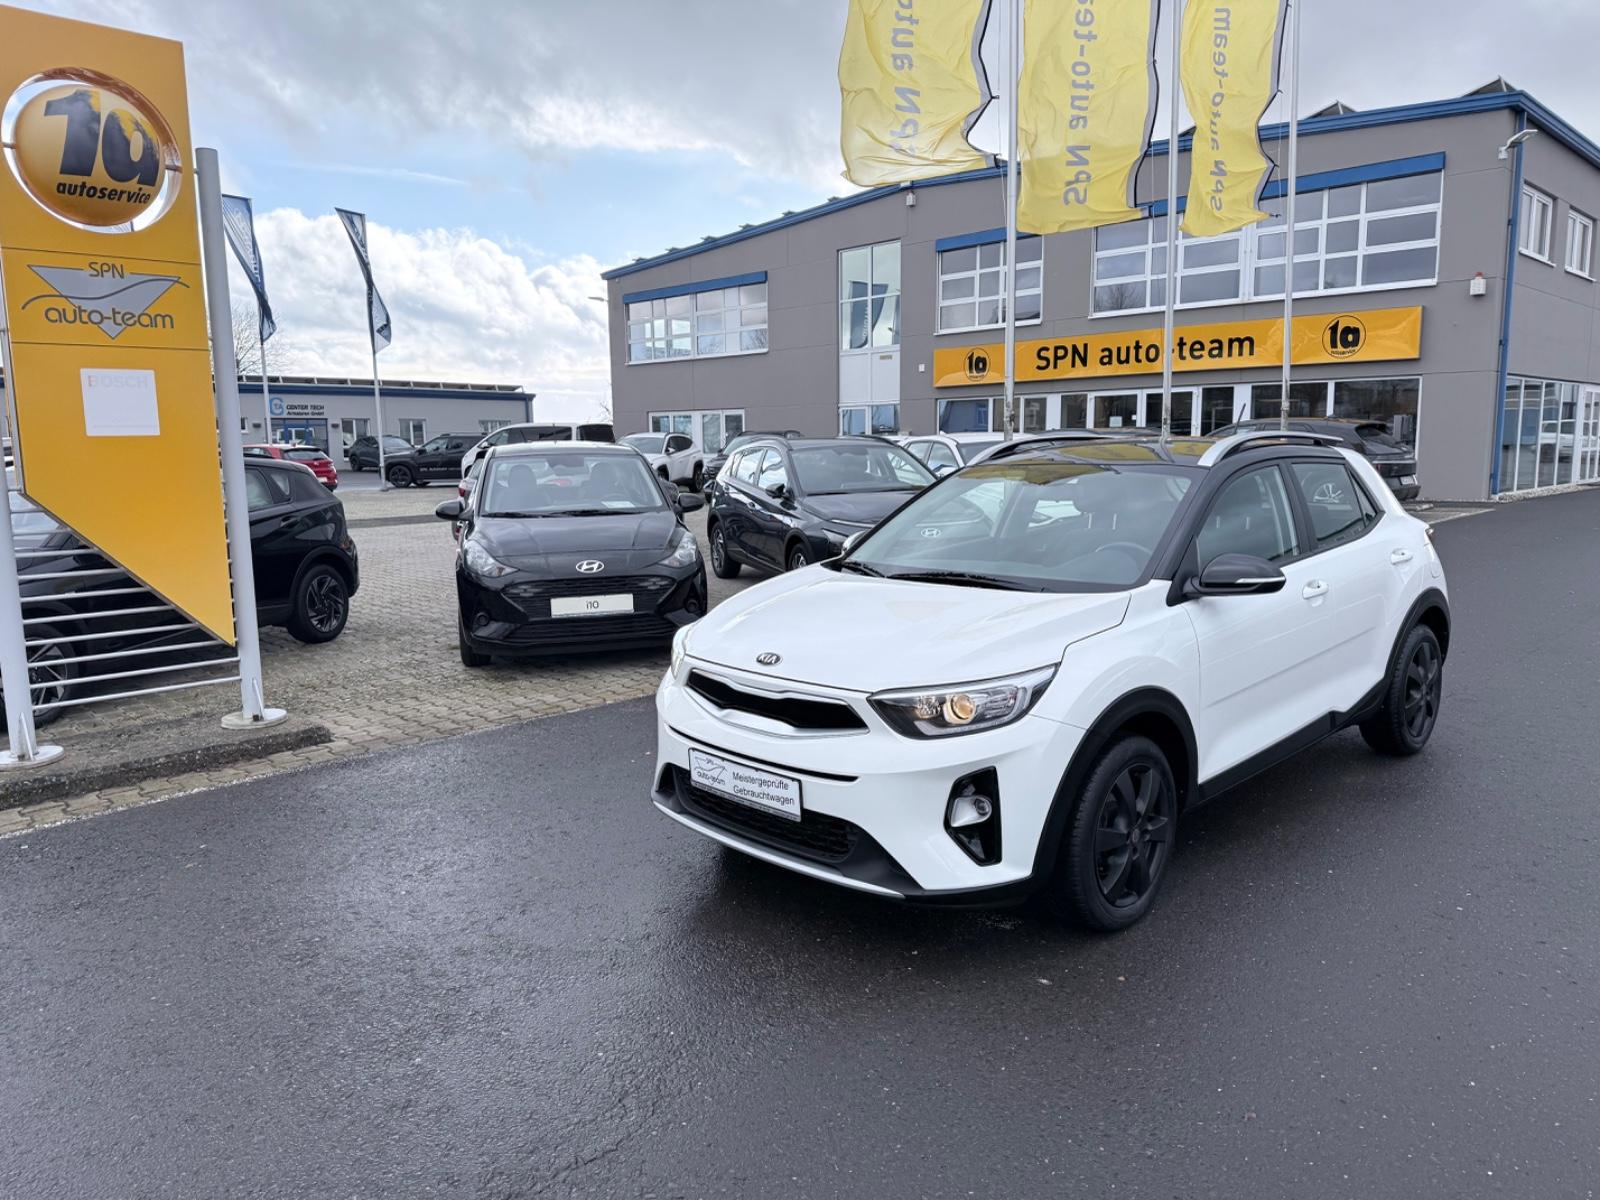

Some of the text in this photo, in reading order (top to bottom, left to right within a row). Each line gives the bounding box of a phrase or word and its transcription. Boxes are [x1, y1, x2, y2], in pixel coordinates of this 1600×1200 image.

[44, 89, 160, 187] 1a
[56, 181, 151, 204] autoservice
[88, 262, 125, 279] SPN
[44, 305, 175, 329] auto-team
[1328, 319, 1360, 349] 1a
[1036, 335, 1255, 371] SPN autoteam
[87, 375, 148, 388] BOSCH
[733, 771, 788, 790] Meistergeprüfte
[733, 785, 795, 806] Gebrauchtwagen
